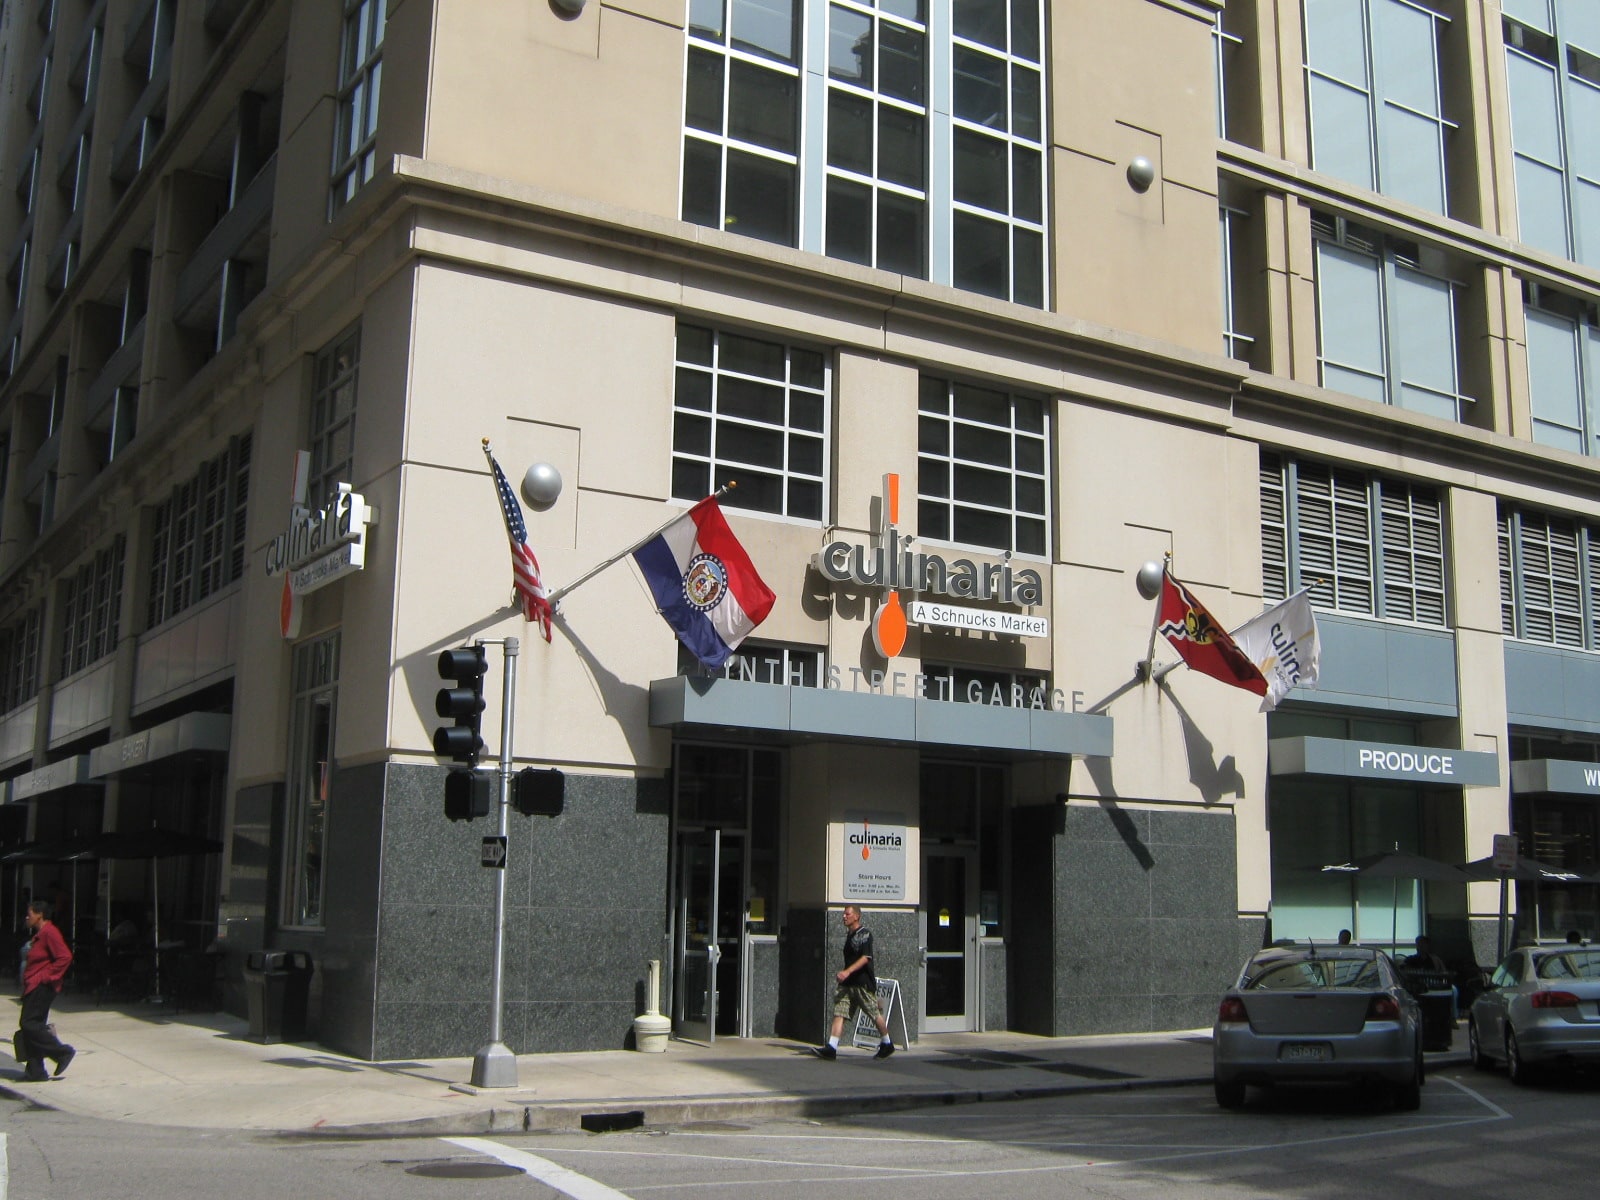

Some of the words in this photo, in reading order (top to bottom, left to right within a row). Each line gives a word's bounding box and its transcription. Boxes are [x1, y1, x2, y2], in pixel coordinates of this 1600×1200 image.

[266, 482, 352, 577] culinaria
[822, 529, 1042, 606] culinaria
[916, 605, 926, 619] A
[931, 606, 997, 628] Schnucks
[1001, 618, 1046, 634] Market
[725, 655, 804, 688] INTH
[827, 664, 952, 702] STREET
[966, 679, 1085, 714] GARAGE
[1359, 749, 1454, 775] PRODUCE
[849, 830, 902, 847] culinaria
[876, 985, 892, 999] ESH
